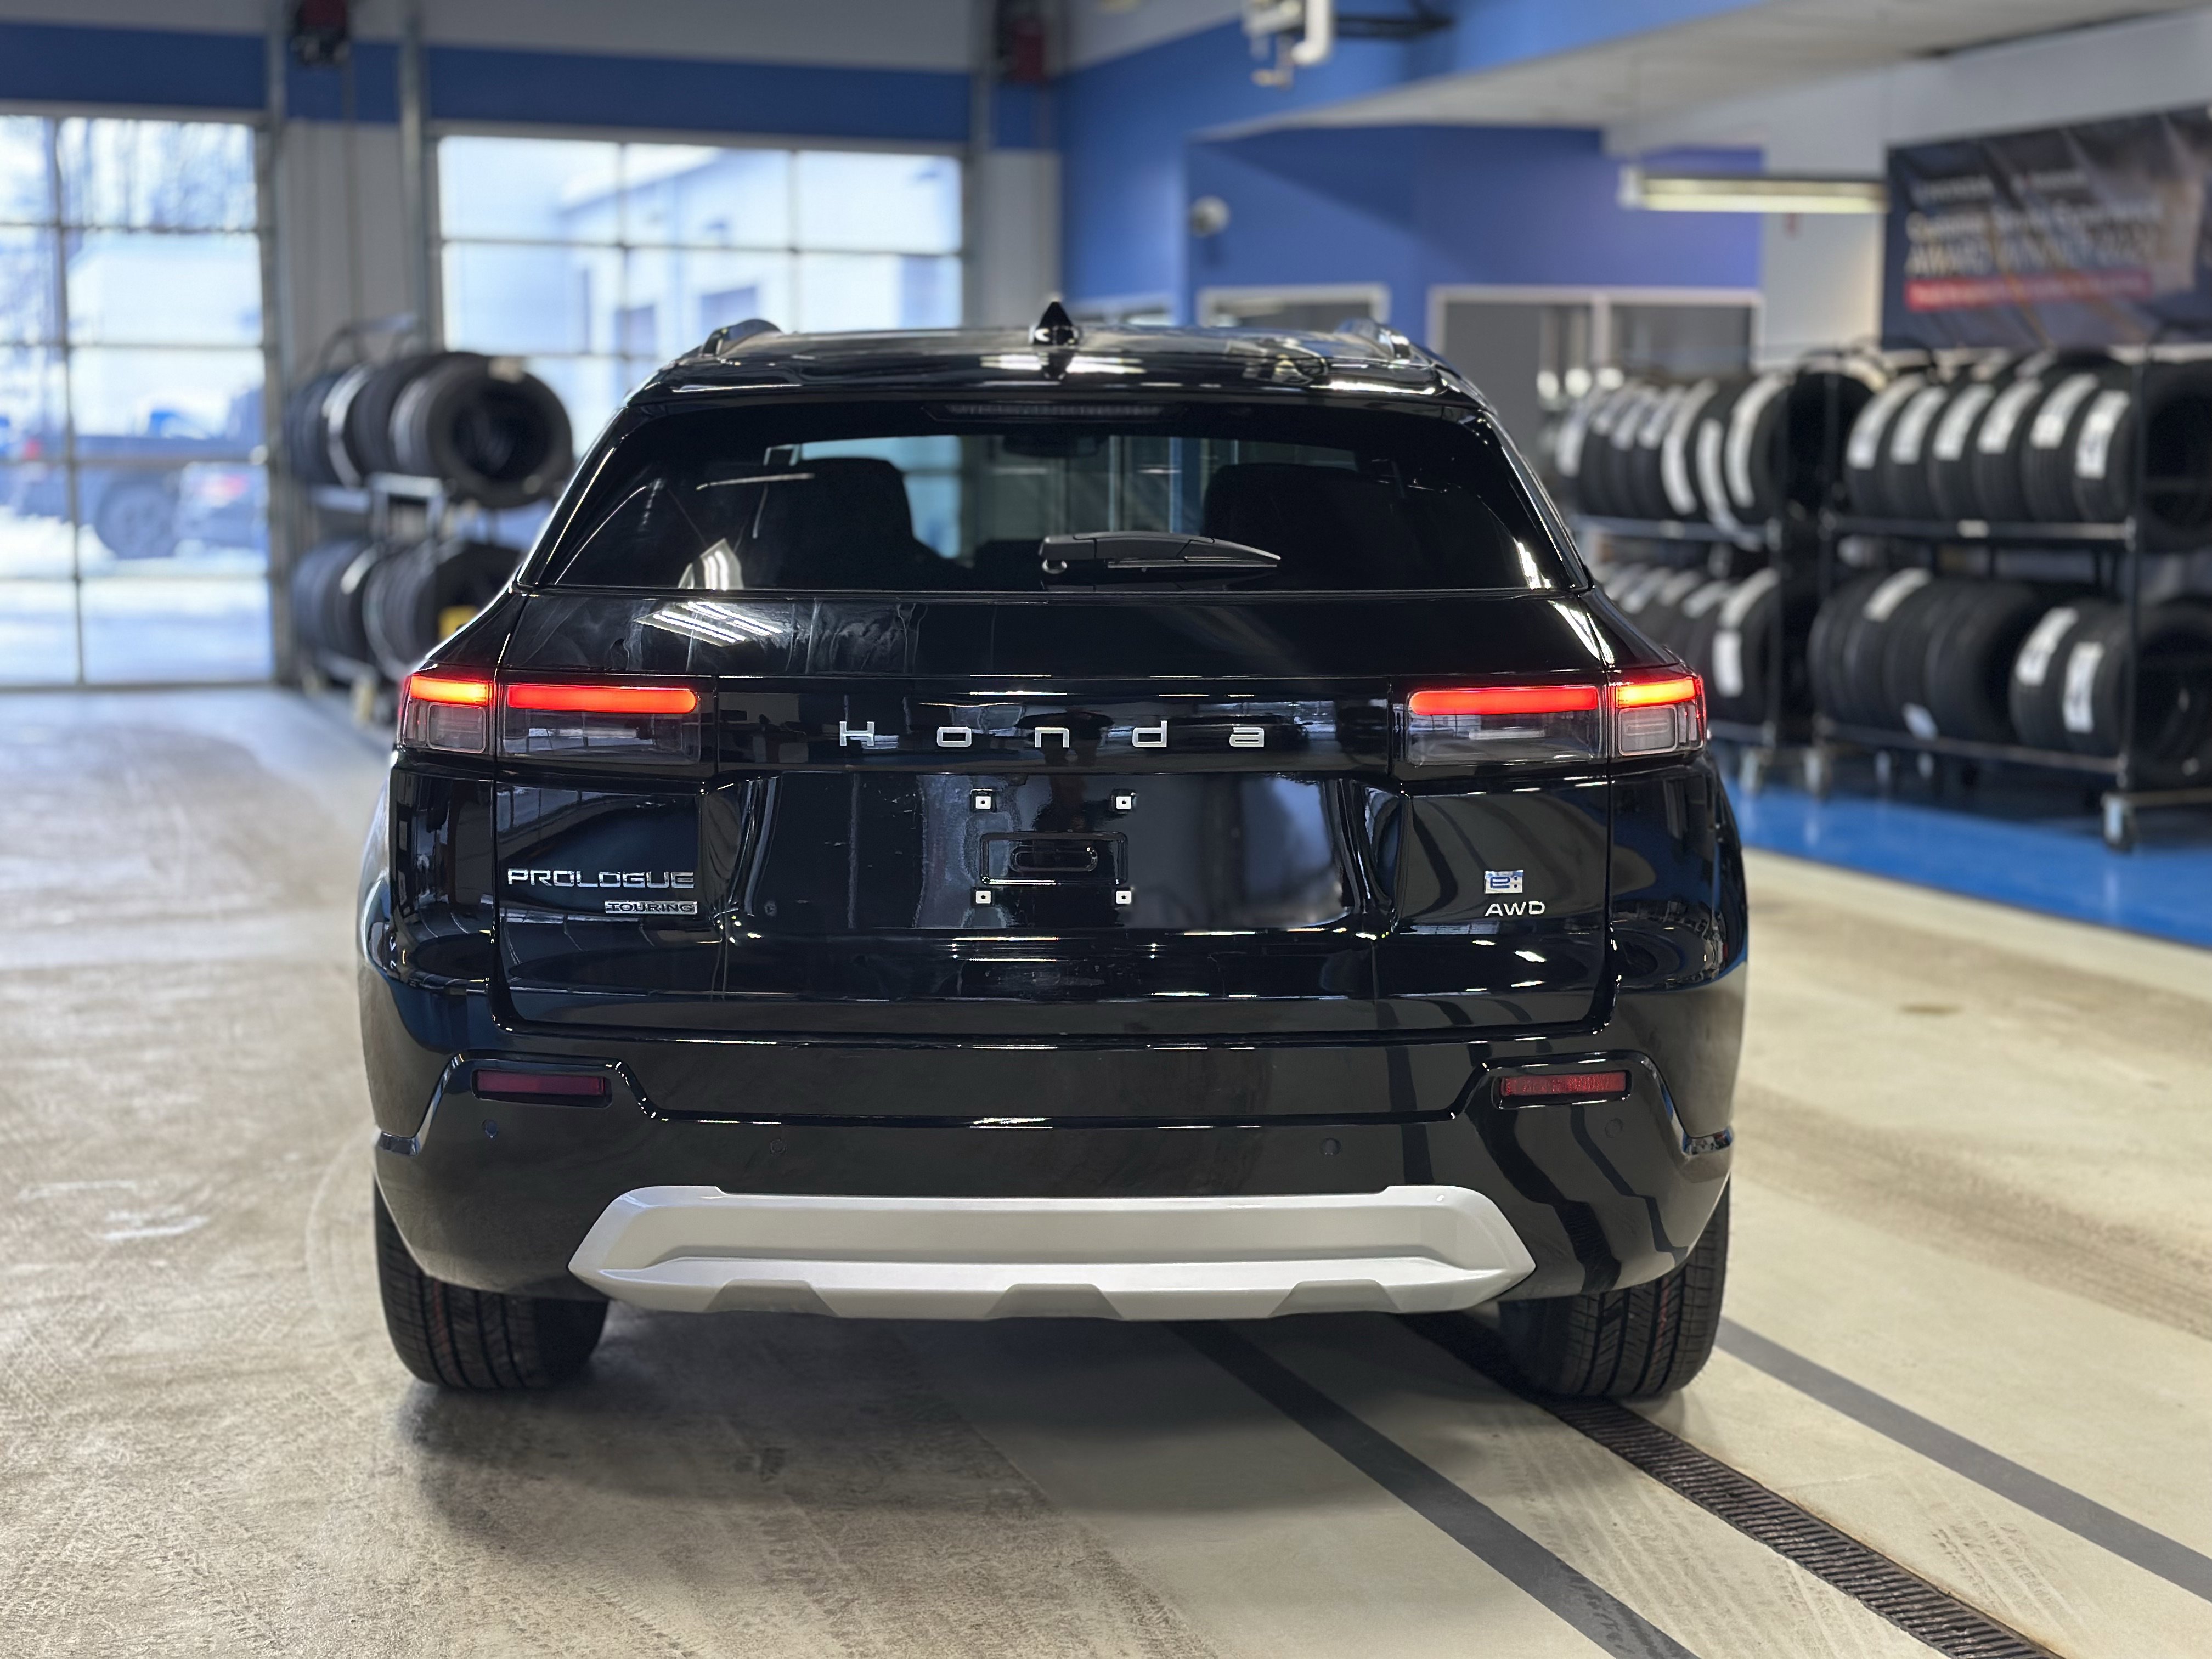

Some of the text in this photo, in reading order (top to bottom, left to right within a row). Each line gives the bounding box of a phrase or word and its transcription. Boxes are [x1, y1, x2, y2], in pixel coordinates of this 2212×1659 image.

[507, 868, 695, 888] PROLOGUE
[608, 902, 695, 912] TOURING
[1485, 901, 1545, 917] AWD
